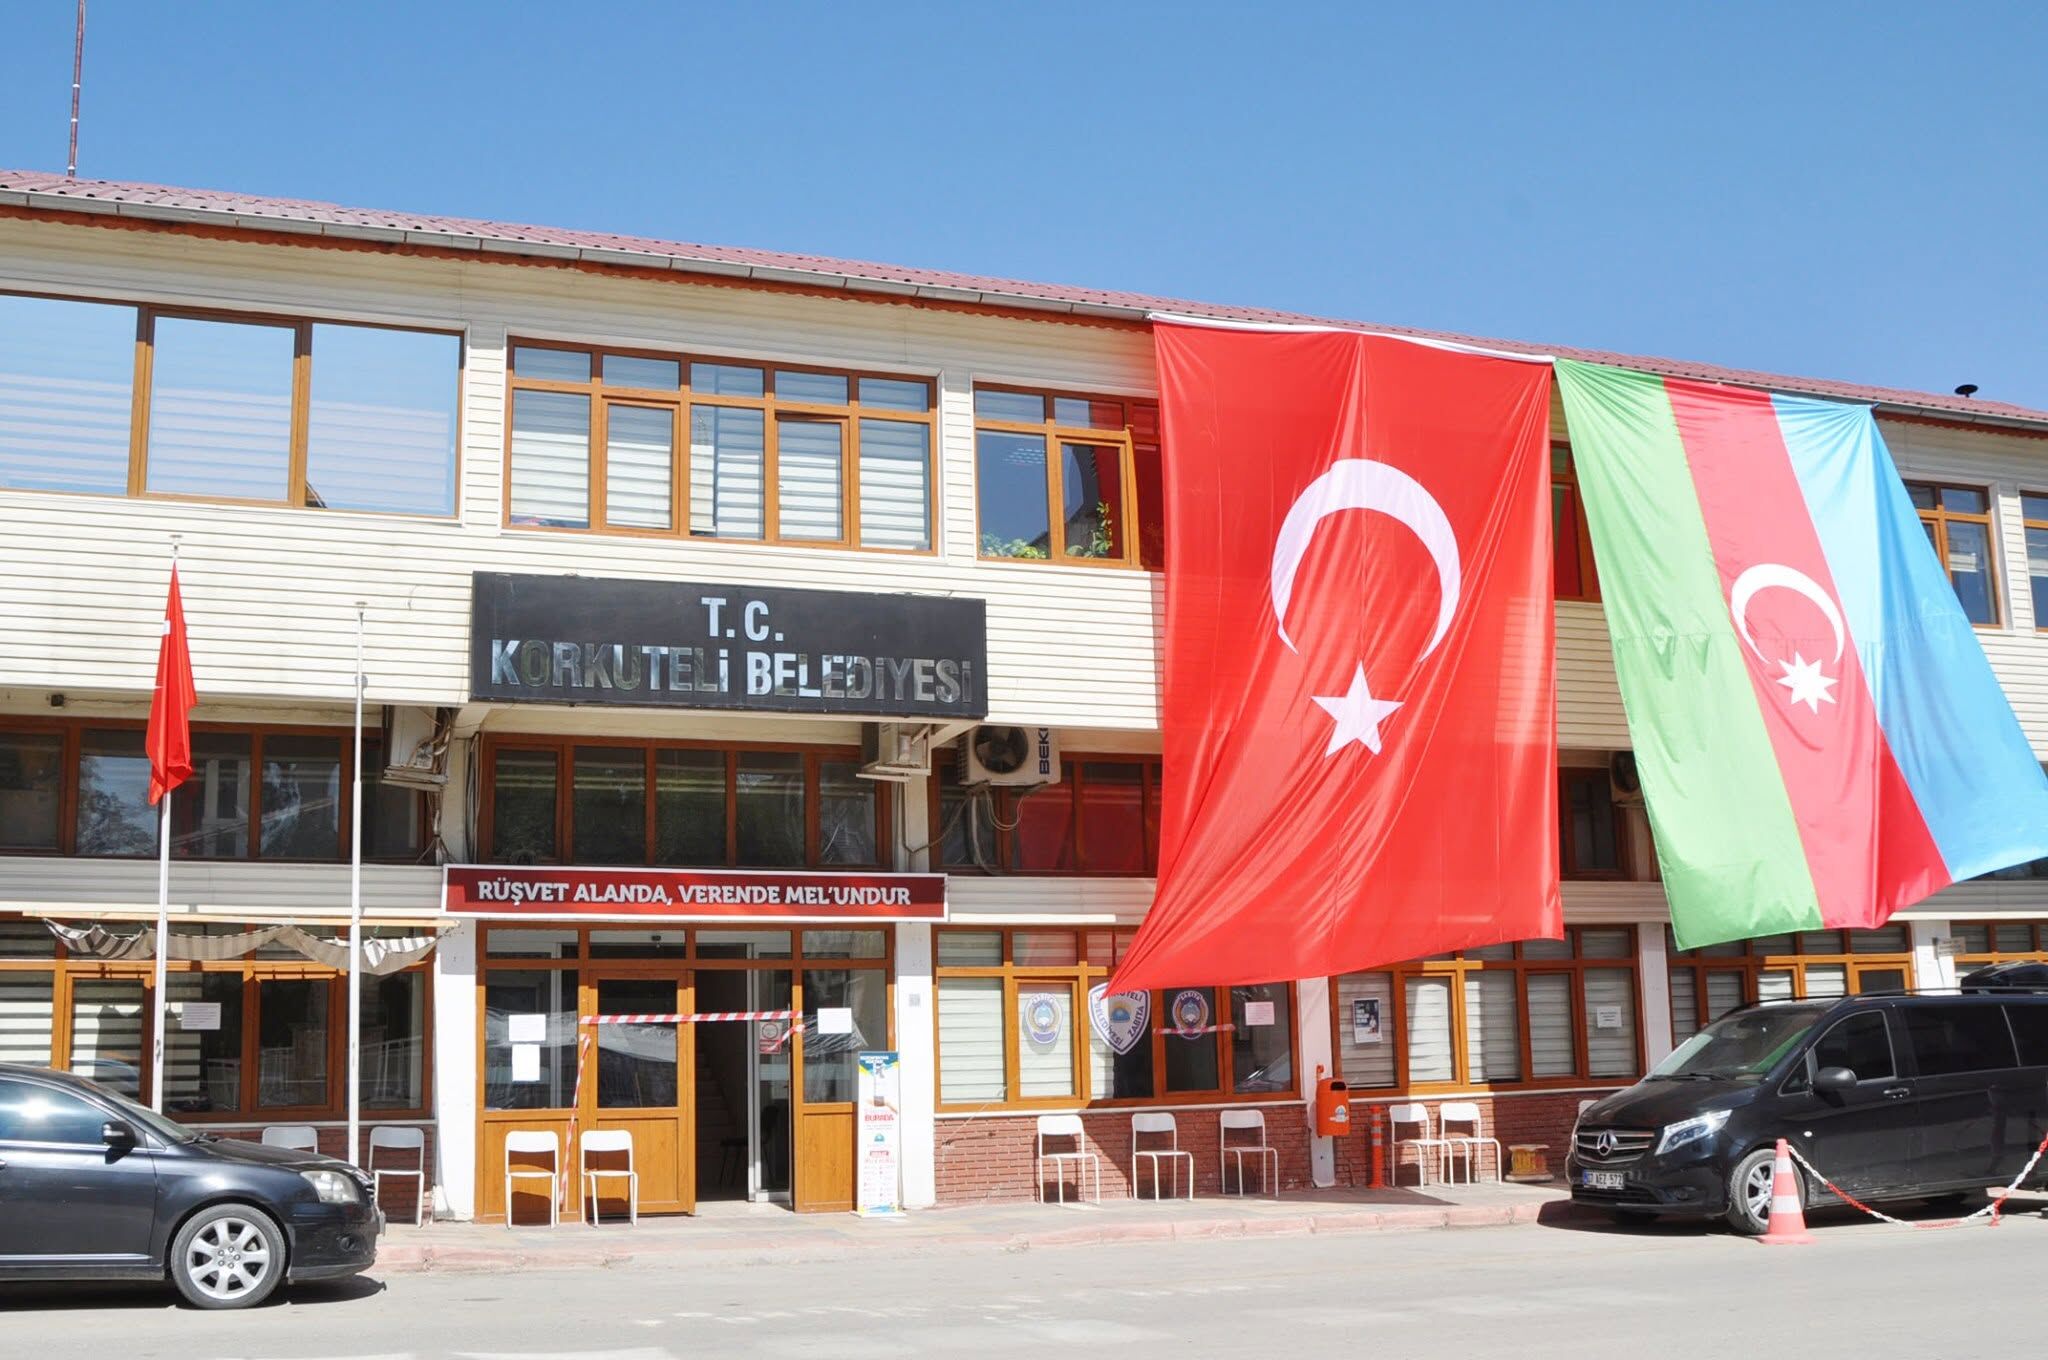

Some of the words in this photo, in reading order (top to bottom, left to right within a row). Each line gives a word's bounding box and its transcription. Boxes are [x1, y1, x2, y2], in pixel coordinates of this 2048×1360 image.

[491, 639, 729, 693] KORKUTELİ
[747, 651, 972, 703] BELEDİYESİ
[1038, 727, 1050, 775] BEK
[477, 877, 570, 906] RÜŞVET
[573, 883, 673, 906] ALANDA,
[678, 884, 780, 904] VERENDE
[785, 885, 911, 905] MEL'UNDUR
